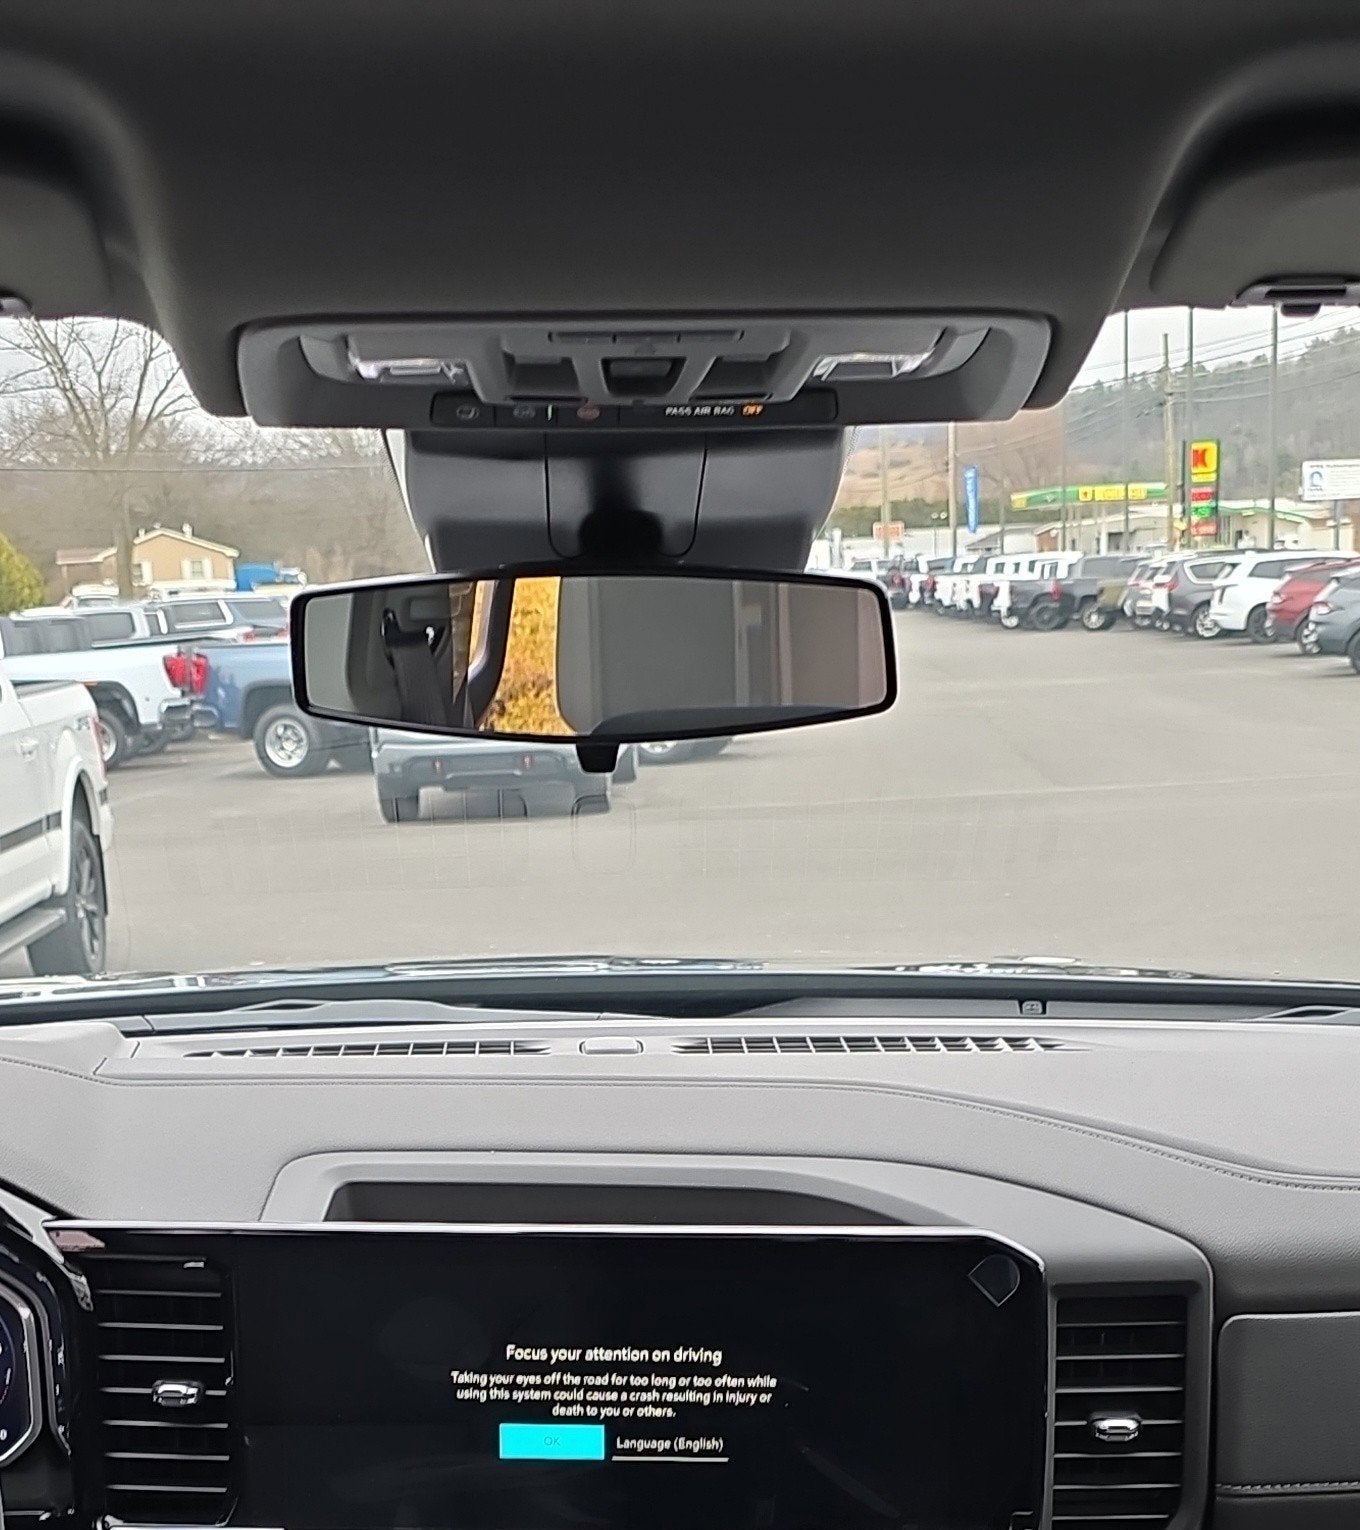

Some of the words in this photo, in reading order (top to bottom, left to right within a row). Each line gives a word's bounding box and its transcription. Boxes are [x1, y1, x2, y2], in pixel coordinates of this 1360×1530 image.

[694, 406, 711, 416] AIR
[713, 406, 735, 416] BAG
[742, 403, 764, 416] OFF
[506, 1344, 547, 1361] Focus
[550, 1349, 581, 1364] your
[585, 1347, 648, 1362] attention
[652, 1351, 670, 1362] on
[673, 1347, 722, 1366] driving
[451, 1370, 487, 1387] Taking
[490, 1374, 514, 1388] your
[516, 1375, 541, 1388] eyes
[543, 1372, 561, 1385] off
[563, 1372, 581, 1386] the
[584, 1374, 608, 1386] road
[611, 1373, 627, 1386] for
[629, 1375, 648, 1387] too
[651, 1374, 676, 1389] long
[679, 1376, 691, 1387] or
[693, 1375, 712, 1387] too
[714, 1374, 744, 1387] often
[747, 1375, 777, 1387] while
[457, 1388, 486, 1402] using
[489, 1388, 510, 1400] this
[512, 1390, 551, 1403] system
[553, 1388, 584, 1401] could
[586, 1391, 618, 1401] cause
[620, 1392, 628, 1401] a
[629, 1389, 659, 1401] crash
[662, 1389, 711, 1404] resulting
[713, 1390, 723, 1402] in
[726, 1391, 757, 1405] injury
[759, 1392, 772, 1403] or
[553, 1405, 584, 1417] death
[586, 1406, 598, 1416] to
[600, 1407, 620, 1420] you
[623, 1407, 634, 1417] or
[637, 1406, 676, 1418] others.
[544, 1436, 561, 1446] OK
[616, 1437, 671, 1451] Language
[674, 1436, 724, 1452] (English)
